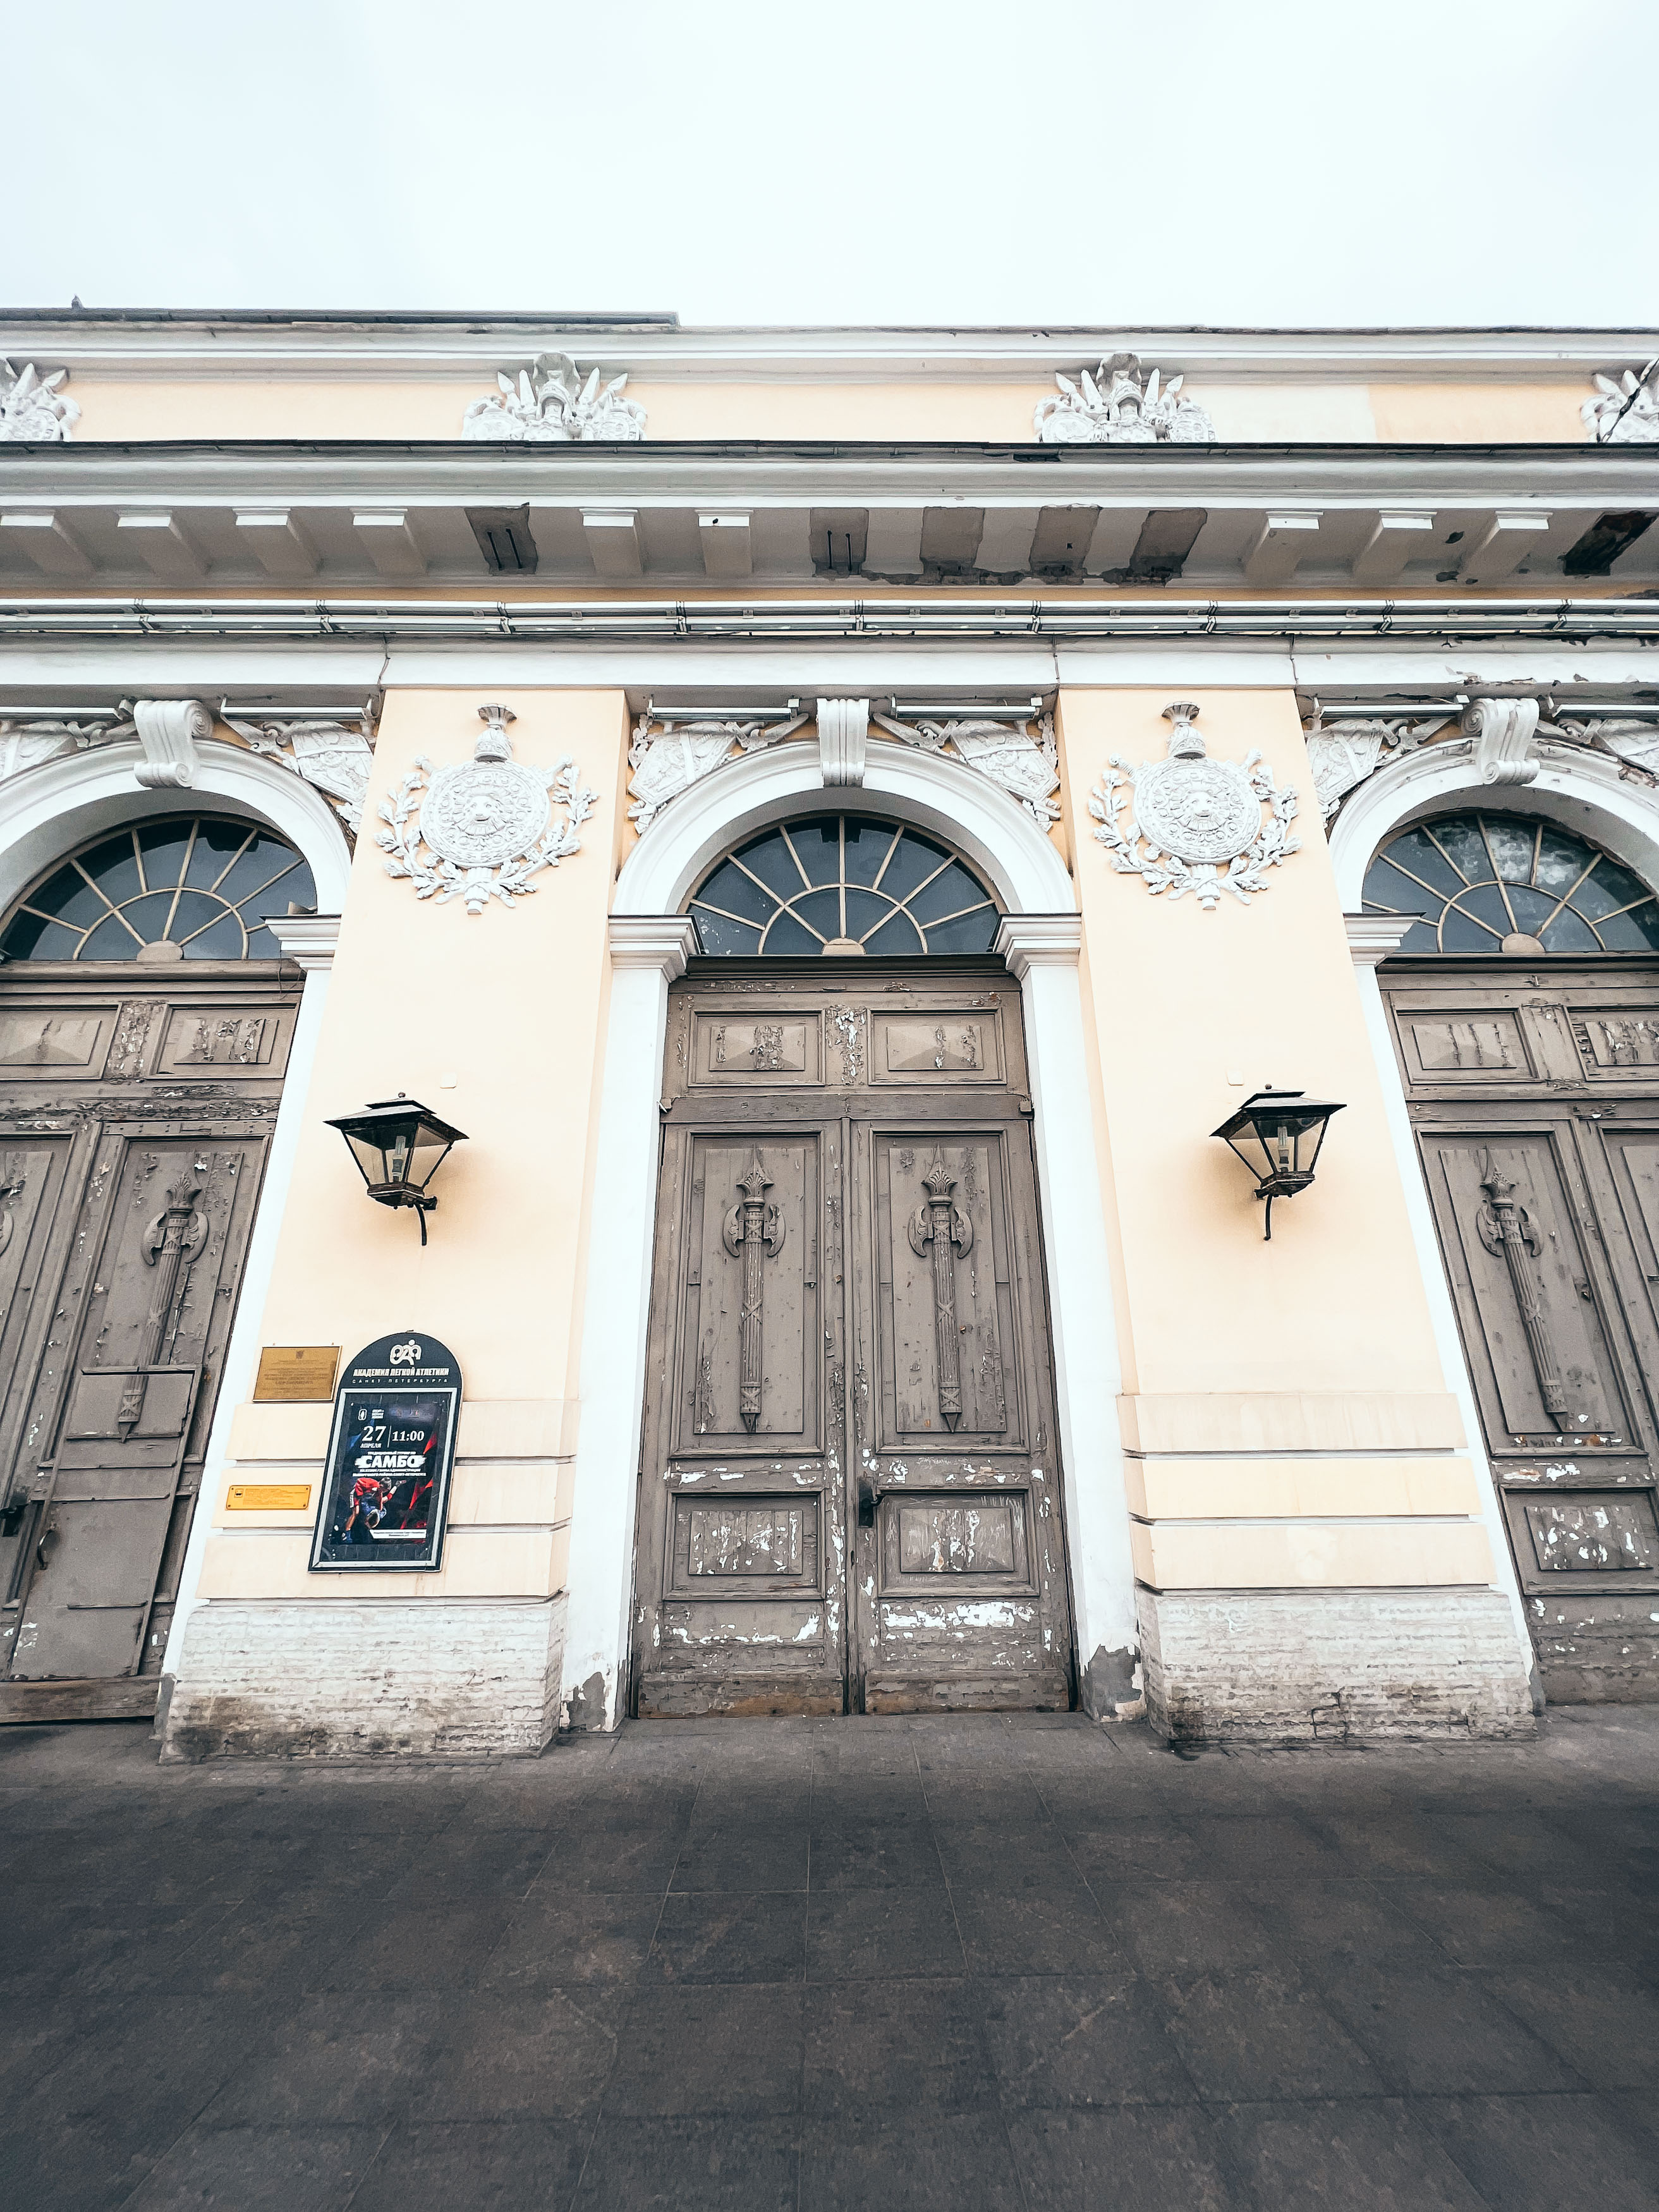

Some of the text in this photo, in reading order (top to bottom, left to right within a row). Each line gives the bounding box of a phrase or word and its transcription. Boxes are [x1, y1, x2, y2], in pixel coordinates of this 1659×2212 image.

[390, 1367, 415, 1376] ЛЕГКОЙ
[362, 1426, 424, 1441] 27 11:00
[362, 1455, 420, 1468] САМБО
